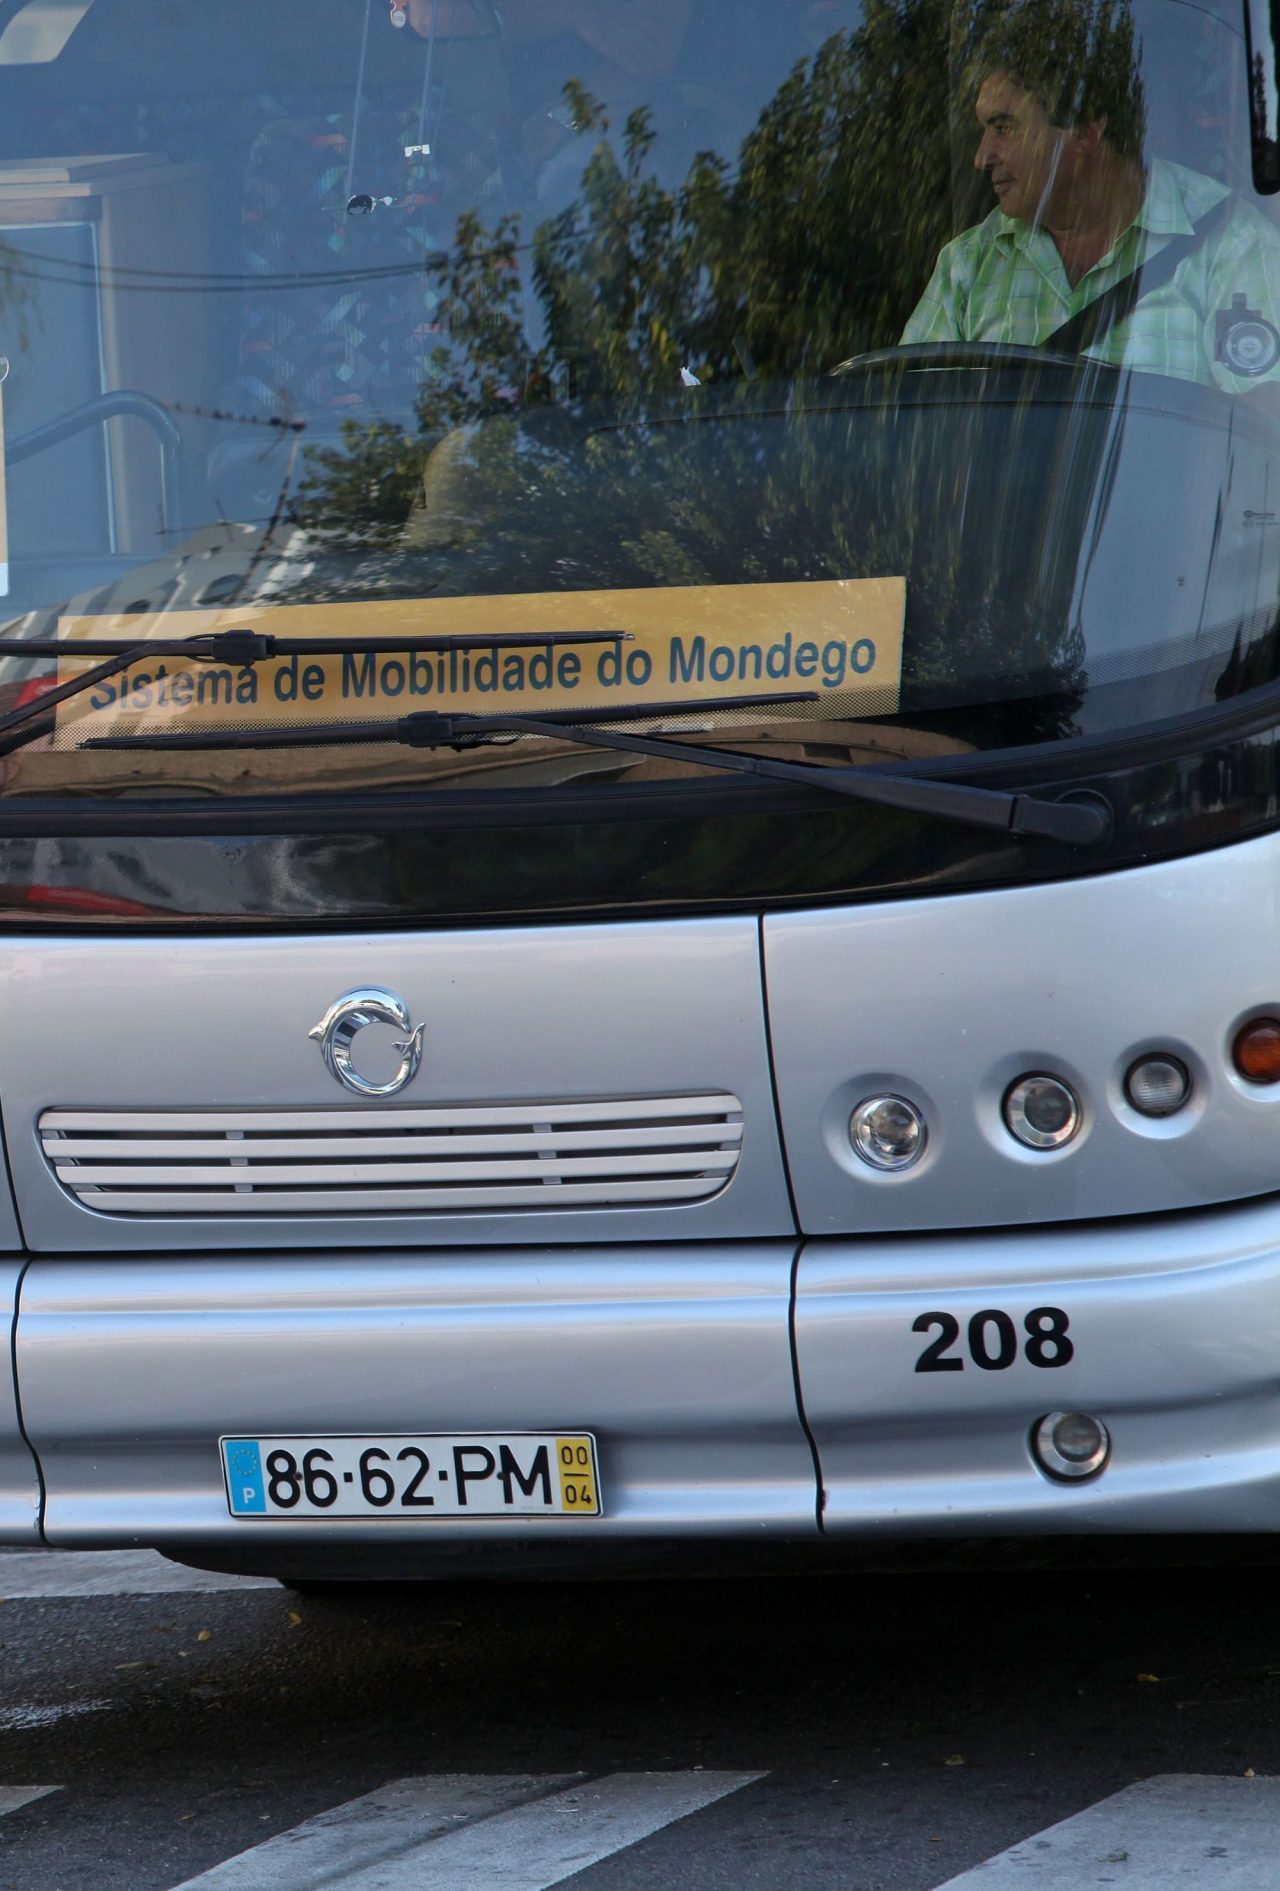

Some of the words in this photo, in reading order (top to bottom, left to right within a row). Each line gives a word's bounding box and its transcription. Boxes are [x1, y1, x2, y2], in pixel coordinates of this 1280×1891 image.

[90, 663, 258, 711] Sistema
[274, 654, 326, 701] de
[342, 648, 581, 697] Mobilidade
[597, 640, 653, 686] do
[669, 632, 877, 688] Mondego
[911, 1306, 1075, 1373] 208
[560, 1445, 588, 1466] 00
[243, 1486, 256, 1504] P
[564, 1484, 593, 1505] 04
